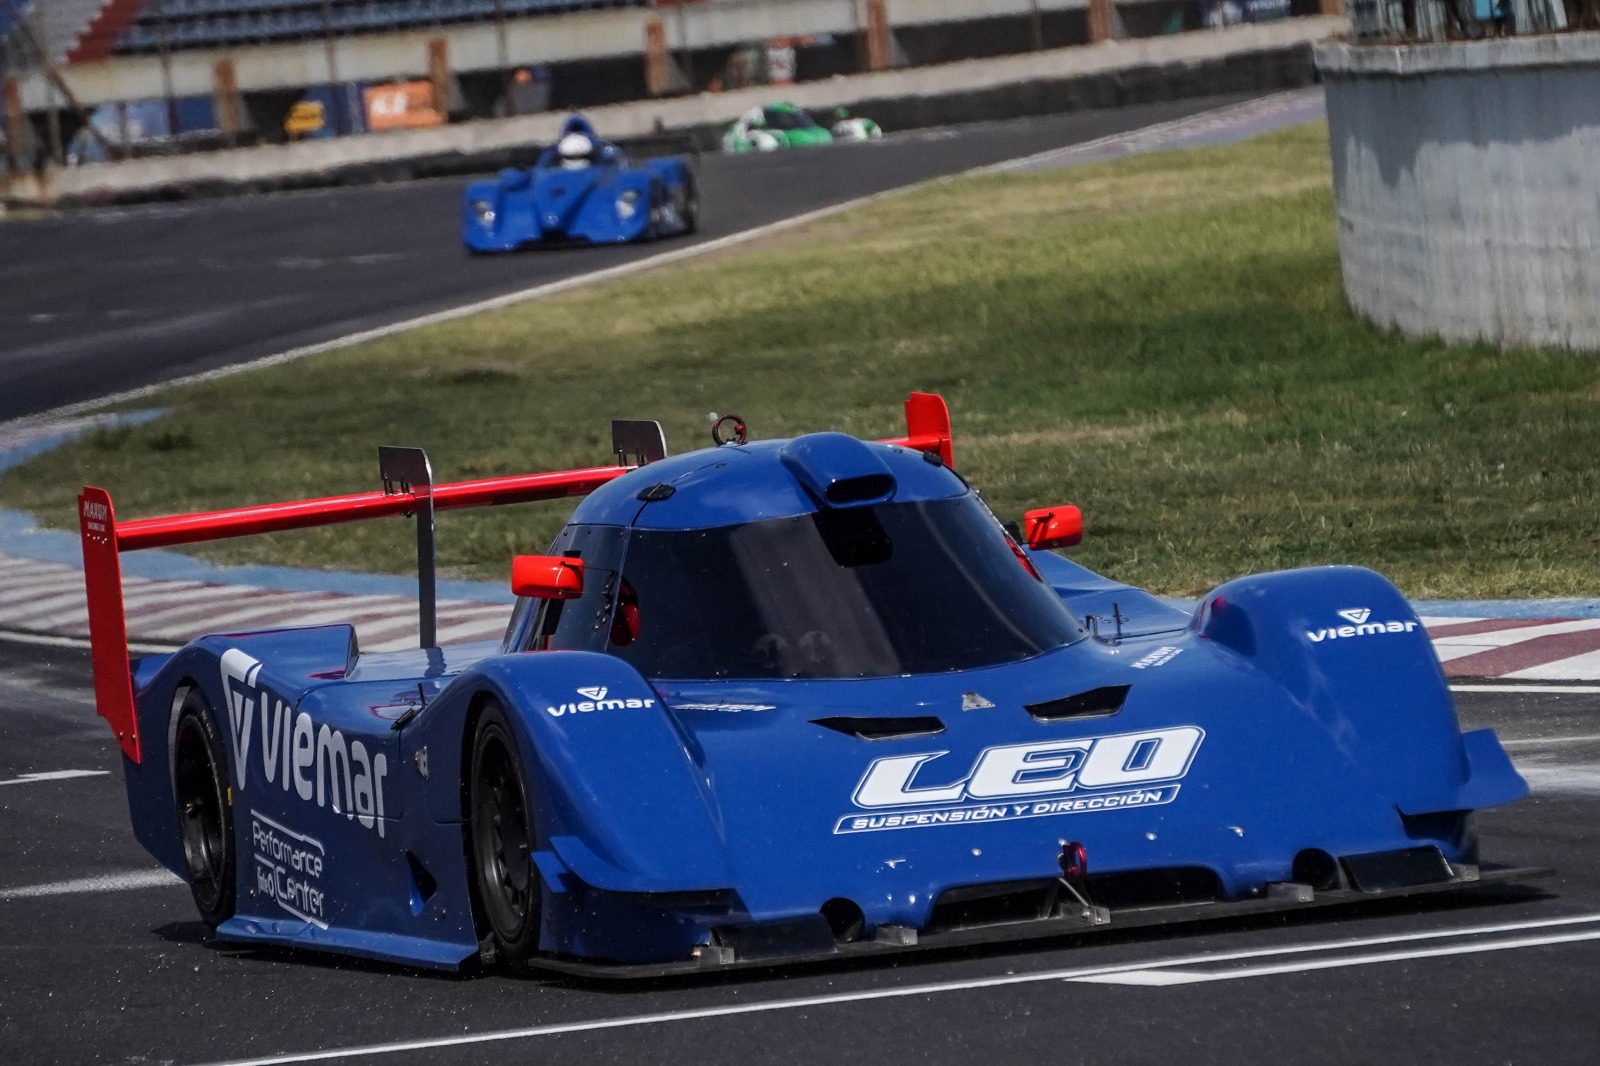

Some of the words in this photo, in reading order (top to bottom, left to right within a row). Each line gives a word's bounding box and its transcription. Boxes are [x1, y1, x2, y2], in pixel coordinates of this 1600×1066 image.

[852, 725, 1206, 809] LEO
[852, 805, 1009, 829] SUSPENSIÓN
[1013, 804, 1034, 817] Y
[1032, 790, 1163, 814] DIRECCIÓN
[252, 820, 323, 879] Performance
[275, 865, 324, 917] Center
